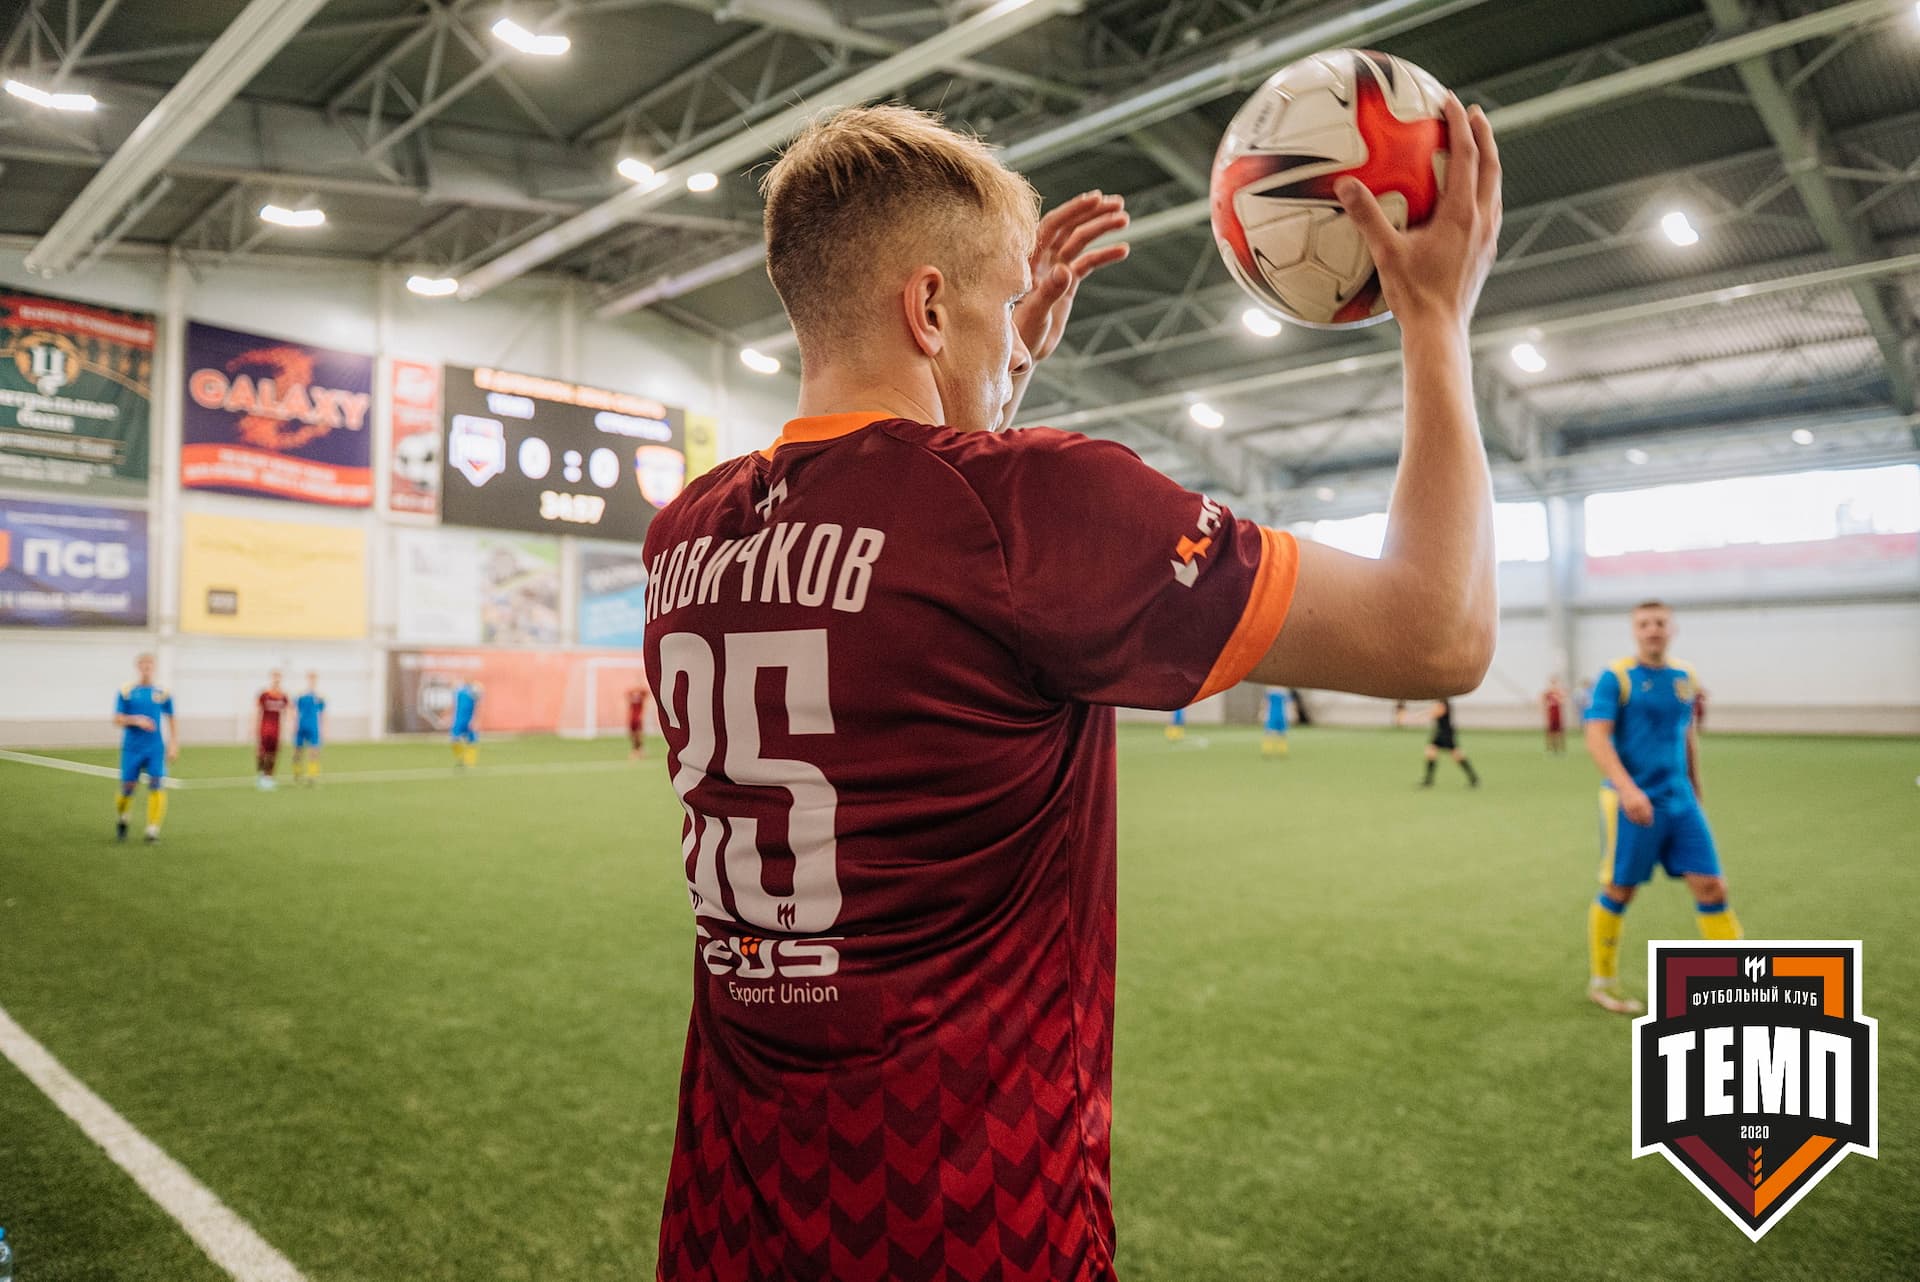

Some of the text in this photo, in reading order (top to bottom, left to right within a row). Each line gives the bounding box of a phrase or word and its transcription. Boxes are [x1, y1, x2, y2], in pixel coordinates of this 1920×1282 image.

[190, 368, 369, 431] GALAXY
[519, 437, 550, 479] 0
[589, 448, 619, 488] 0
[22, 538, 129, 579] ПСБ
[646, 522, 885, 625] НОВИЧКОВ
[728, 981, 838, 1006] Export Union
